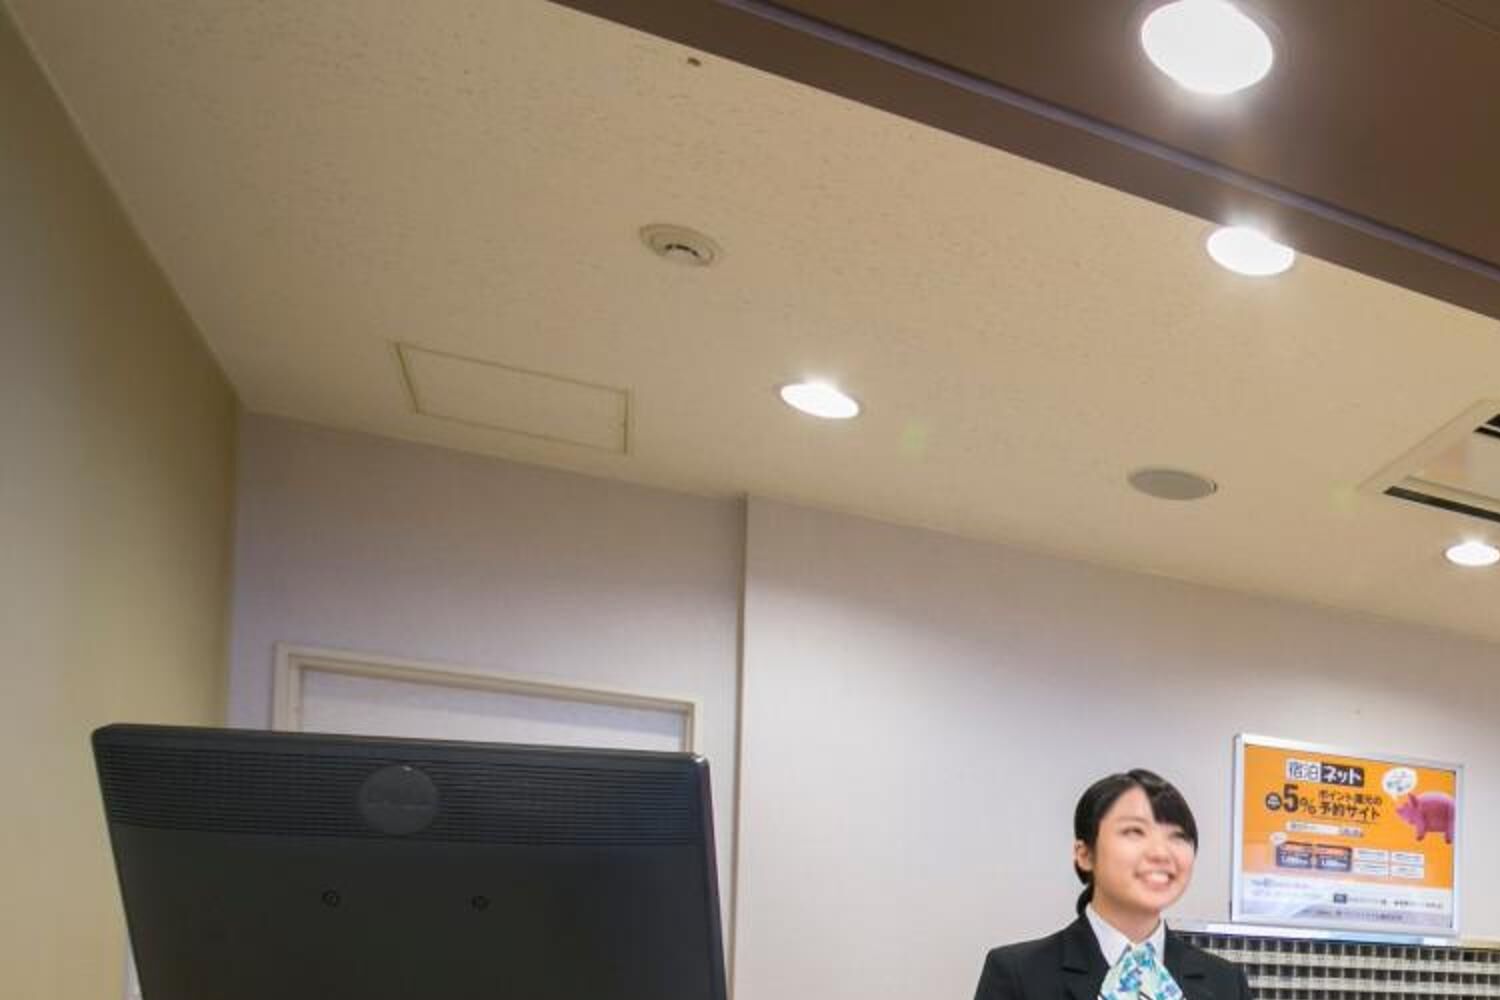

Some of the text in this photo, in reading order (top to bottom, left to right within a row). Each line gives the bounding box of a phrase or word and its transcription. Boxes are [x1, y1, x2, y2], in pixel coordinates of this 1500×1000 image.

[1288, 760, 1362, 785] 宿泊ネット
